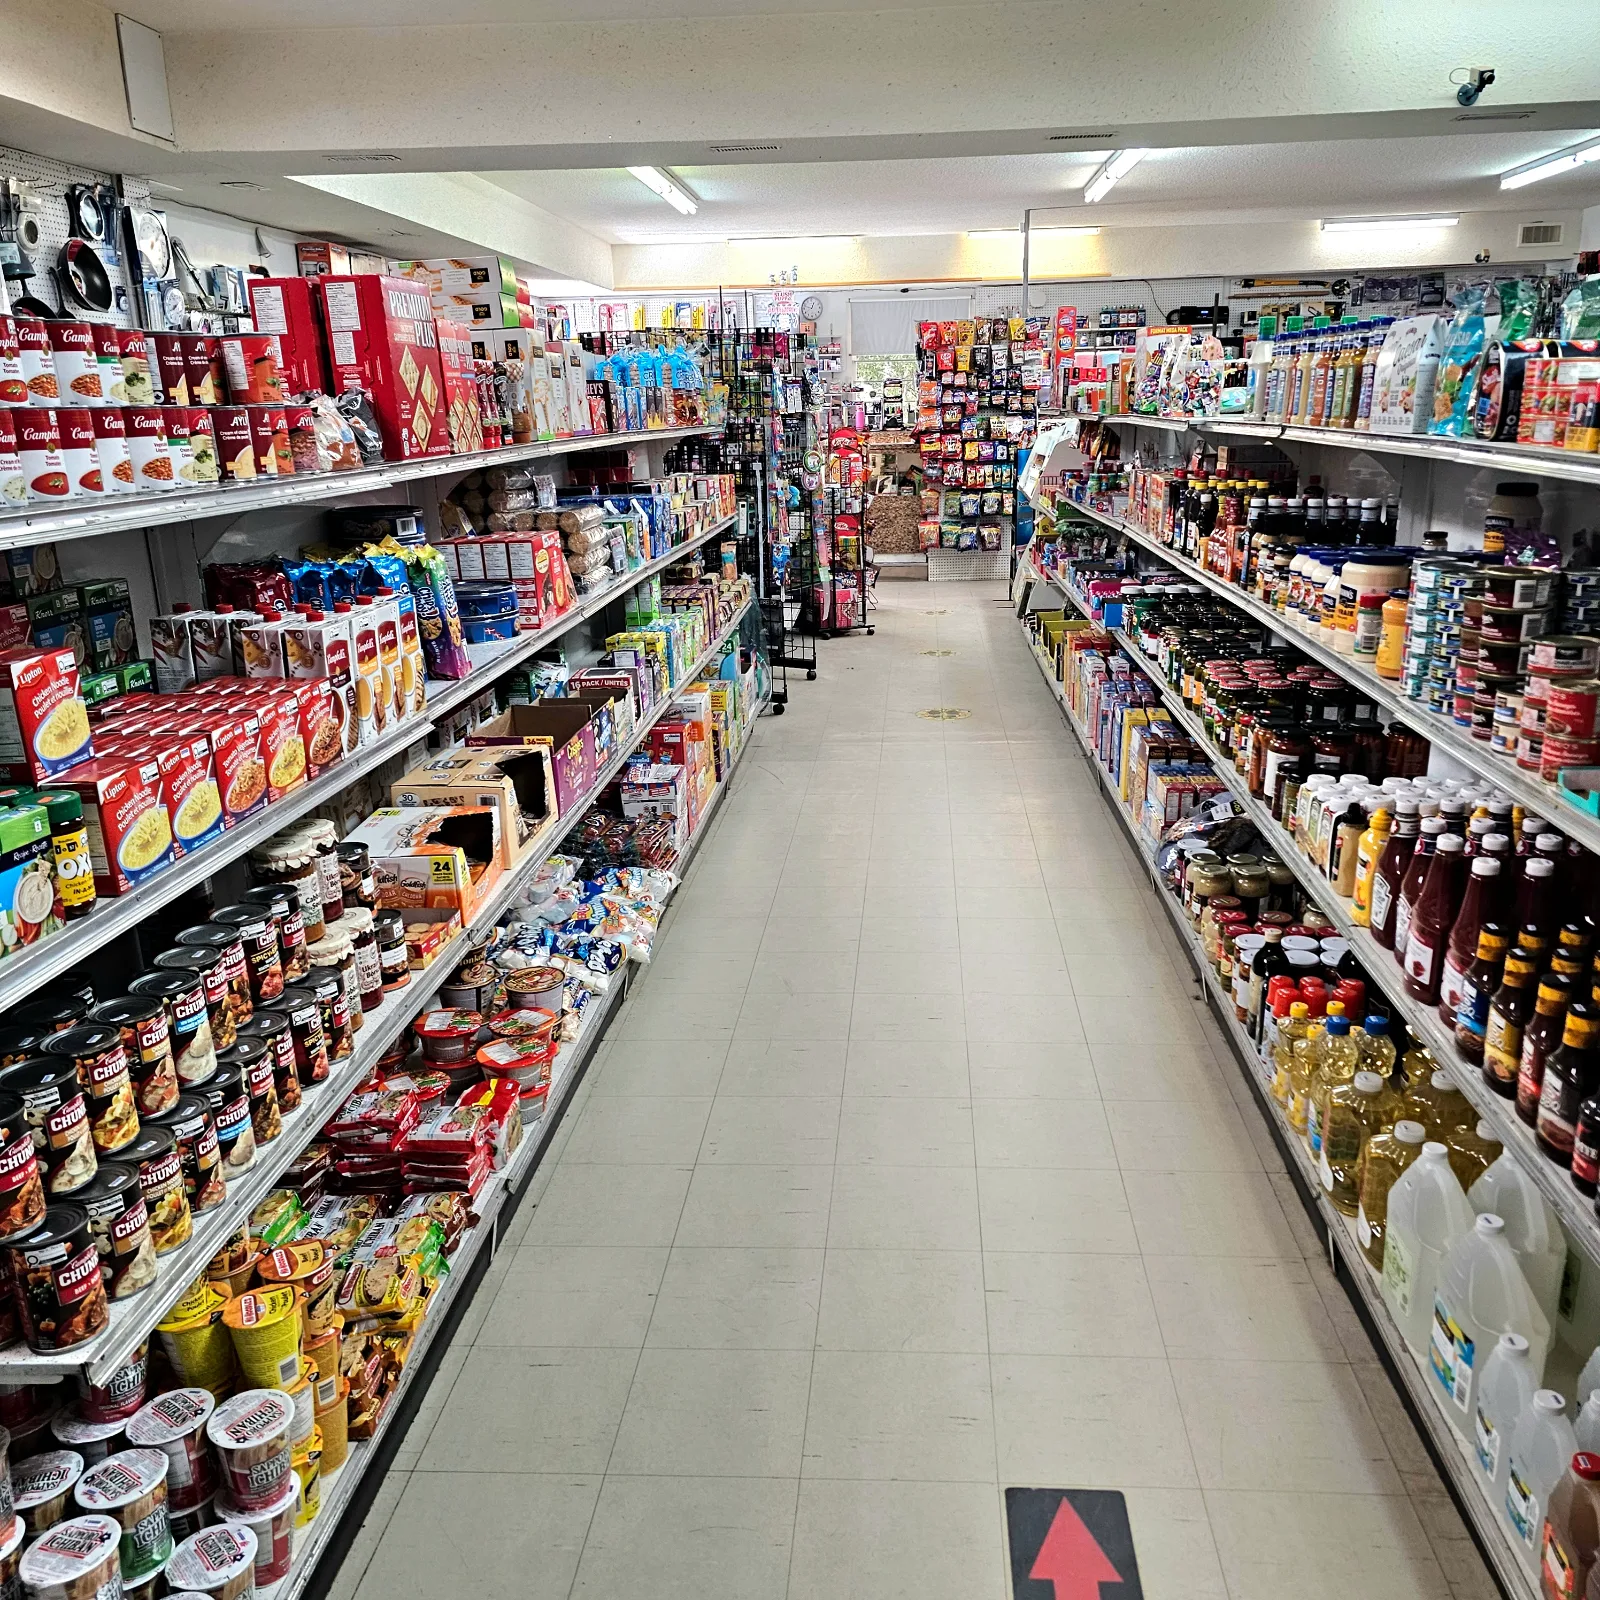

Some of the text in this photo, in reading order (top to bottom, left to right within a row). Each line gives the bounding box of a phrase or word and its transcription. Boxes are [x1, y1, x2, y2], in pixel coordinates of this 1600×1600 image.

[388, 290, 432, 322] PREMIUM
[414, 320, 436, 348] PLUS
[20, 666, 42, 684] Lipton
[570, 680, 581, 689] 16
[582, 680, 600, 688] PACK
[32, 676, 70, 707] Chicken Noodle
[217, 731, 234, 748] Lipton
[161, 754, 180, 772] Lipton
[105, 780, 127, 799] Lipton
[116, 798, 135, 821] Chicken
[433, 861, 451, 872] 24
[401, 880, 426, 890] Goldfish
[230, 1402, 279, 1437] ICHIBAN
[45, 1535, 99, 1554] ICHIBAN
